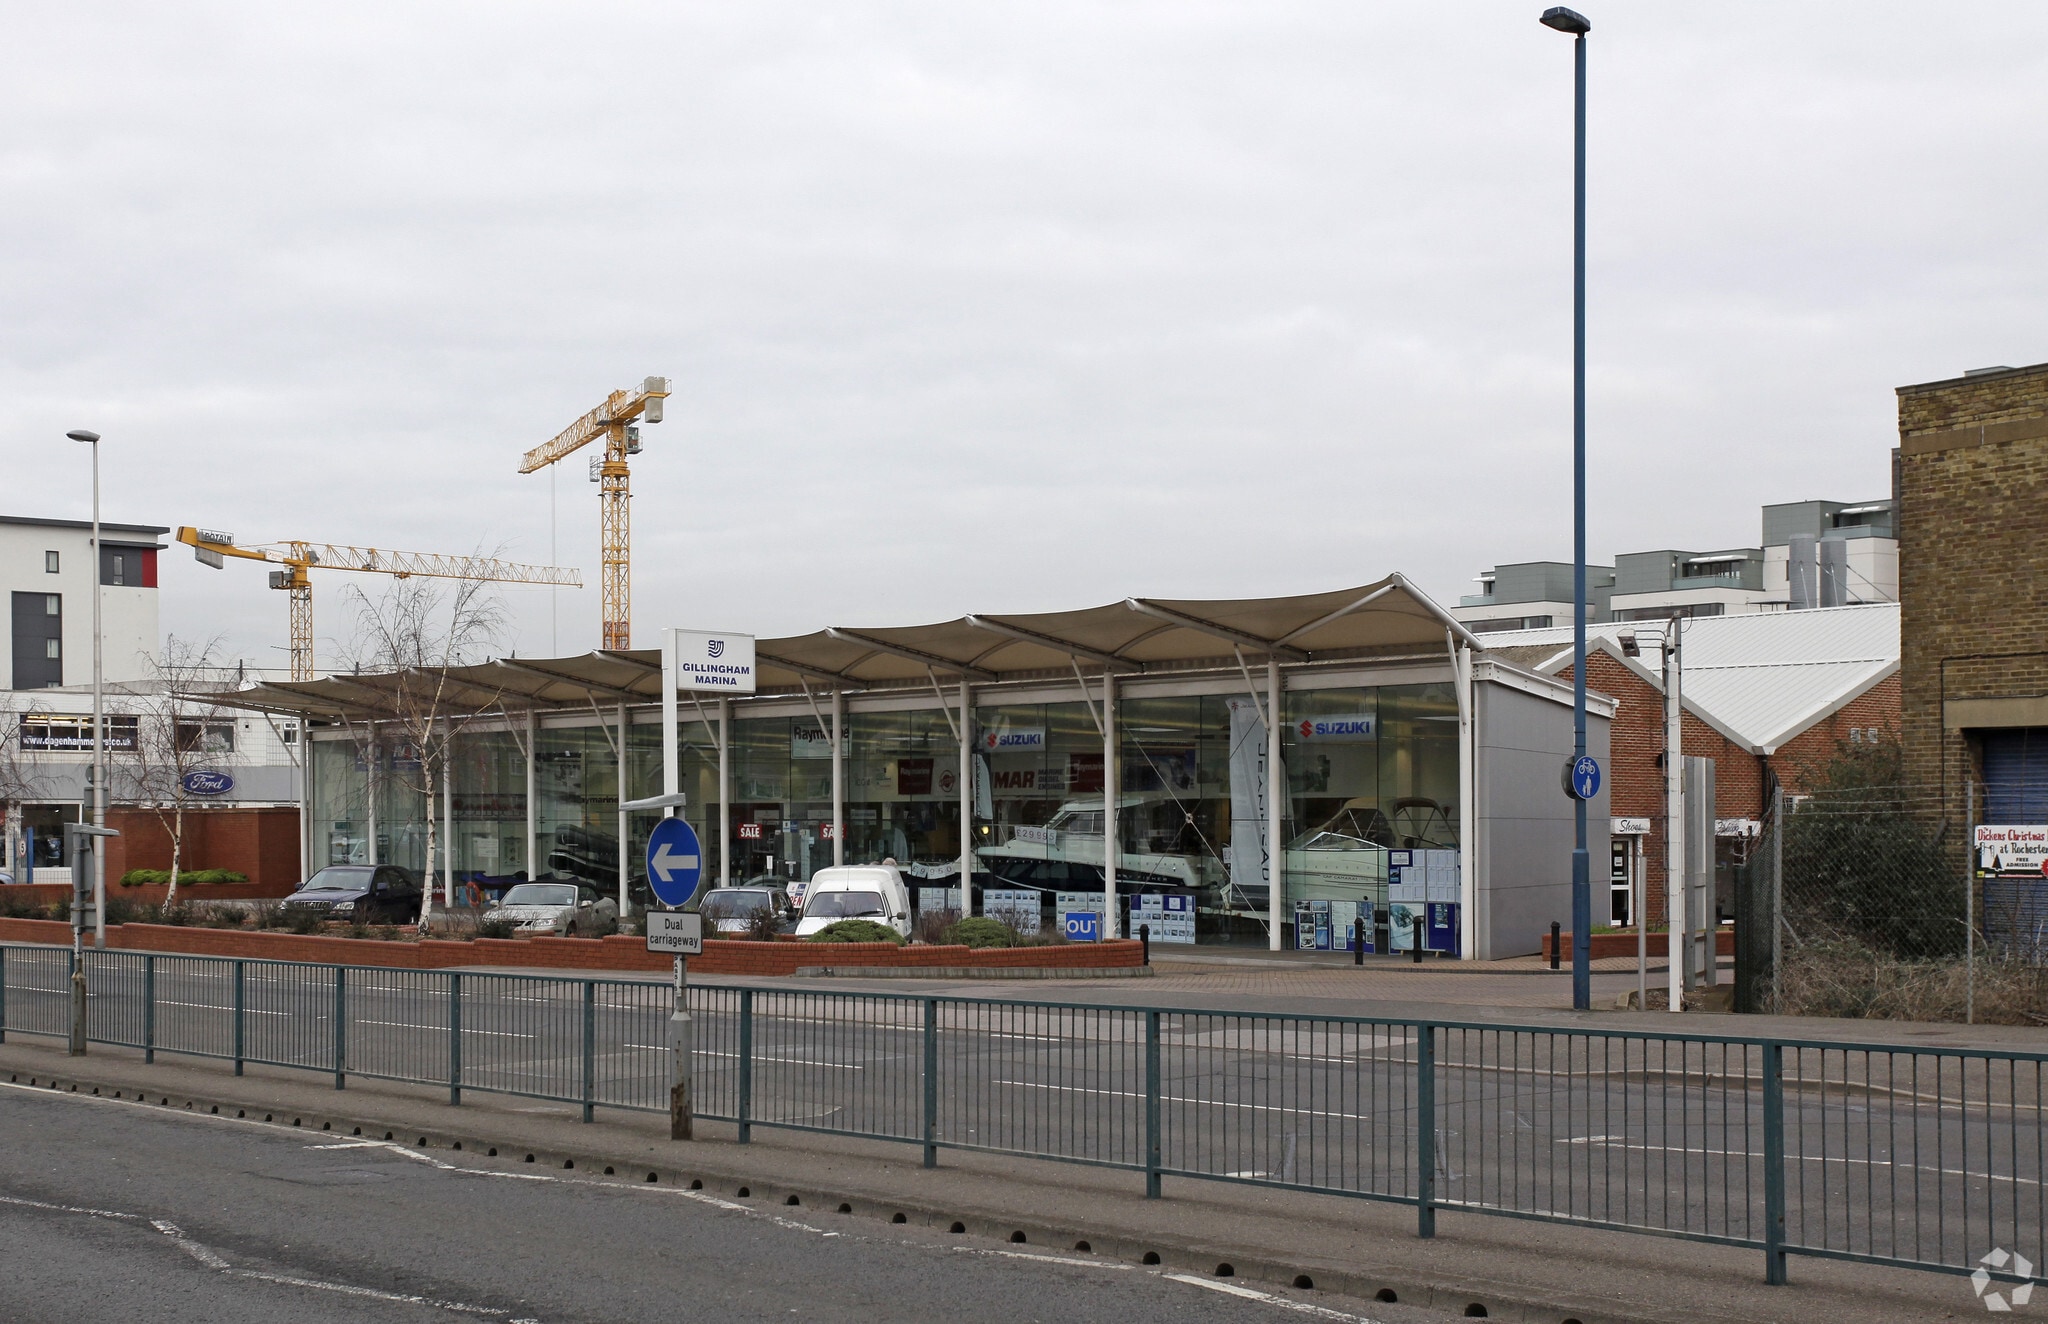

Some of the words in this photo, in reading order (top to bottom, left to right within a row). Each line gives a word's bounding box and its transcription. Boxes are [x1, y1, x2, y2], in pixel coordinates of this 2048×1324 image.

[683, 663, 750, 675] GILLINGHAM
[695, 675, 737, 685] MARINA
[1315, 721, 1370, 735] SUZUKI
[22, 734, 132, 748] www.dagenhammors.co.uk
[999, 733, 1041, 746] SUZUKI
[190, 773, 224, 790] Ford
[740, 827, 760, 838] SALE
[823, 827, 845, 838] SAE
[1978, 829, 2006, 841] Dickens
[2008, 829, 2045, 841] Christmas
[2000, 844, 2009, 854] at
[789, 895, 804, 907] PEN
[664, 918, 684, 930] Dual
[649, 933, 699, 949] carriageway
